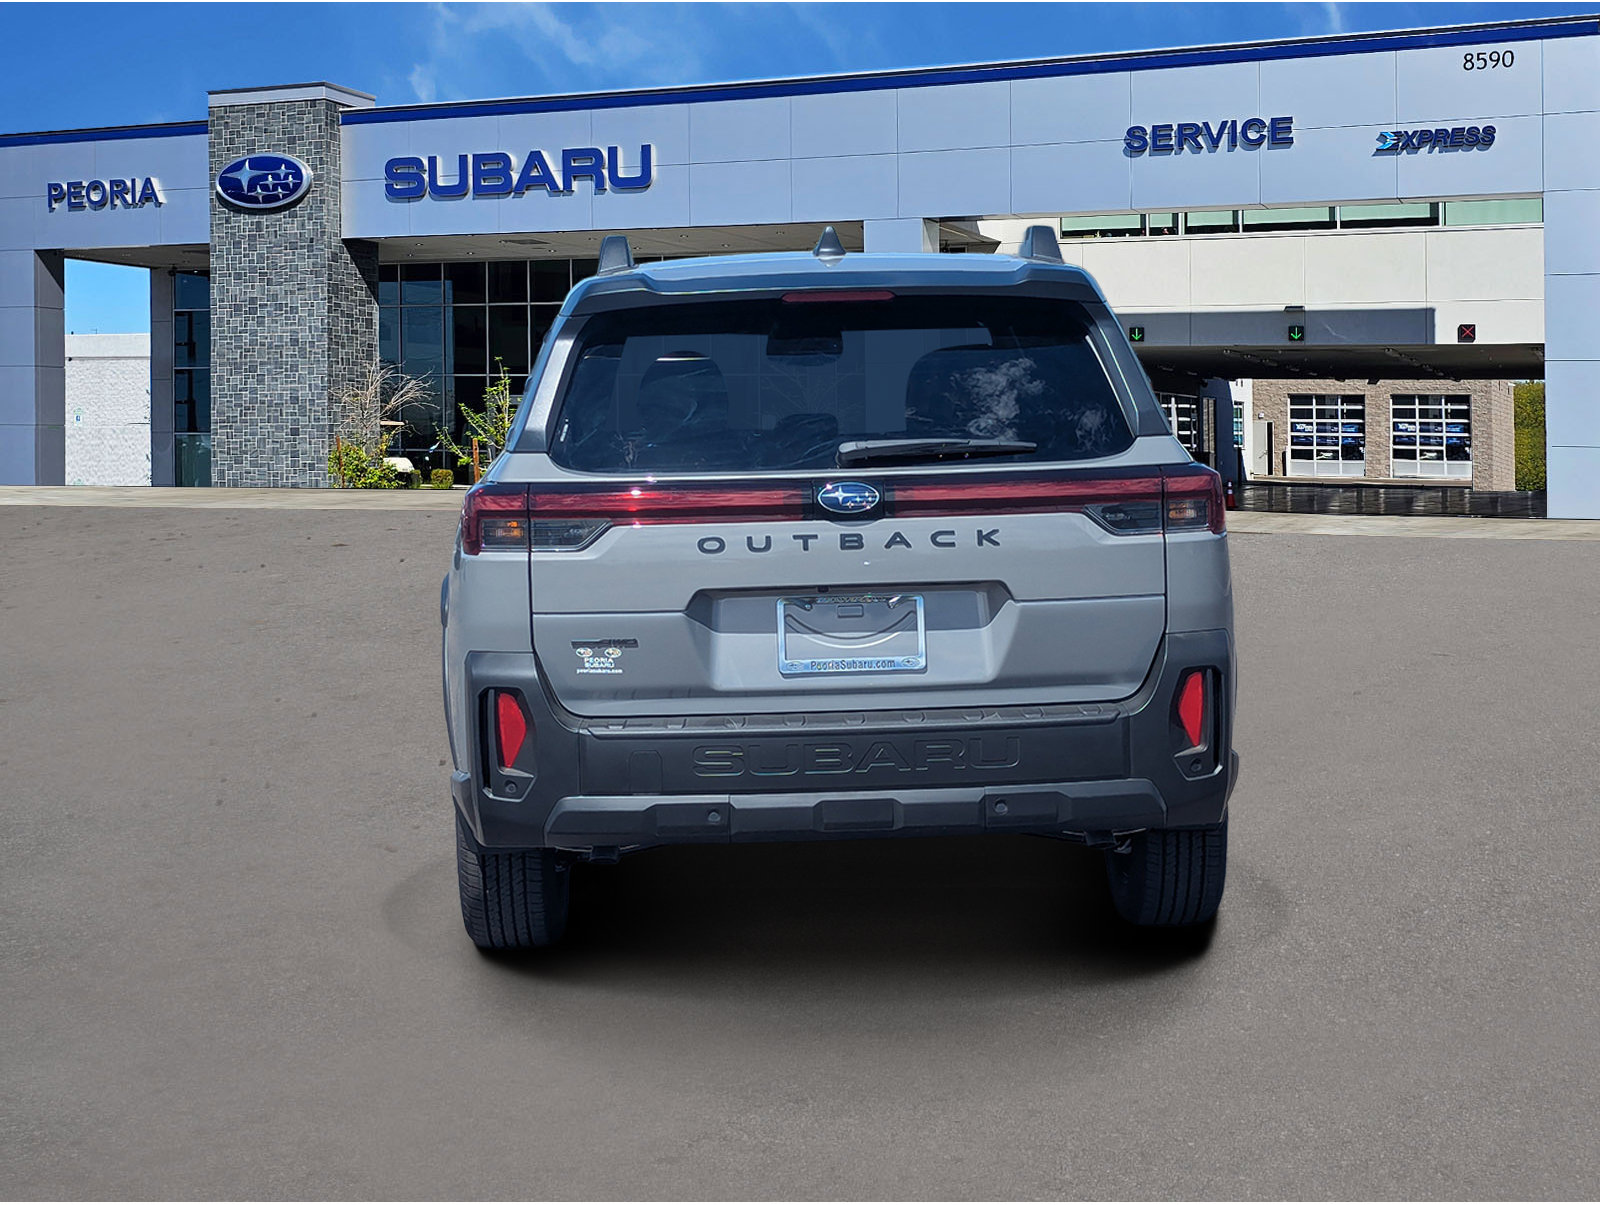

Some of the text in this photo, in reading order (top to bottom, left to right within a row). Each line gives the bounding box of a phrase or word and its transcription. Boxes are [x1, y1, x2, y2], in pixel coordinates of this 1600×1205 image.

[1463, 50, 1515, 70] 8590
[1125, 116, 1294, 152] SERVICE
[1376, 125, 1497, 151] EXPRESS
[384, 143, 652, 200] SUBARU
[47, 177, 163, 211] PEORIA
[696, 529, 1001, 555] OUTBACK
[810, 659, 896, 671] PeoriaSubaru.com
[693, 737, 1021, 777] SUBARU
